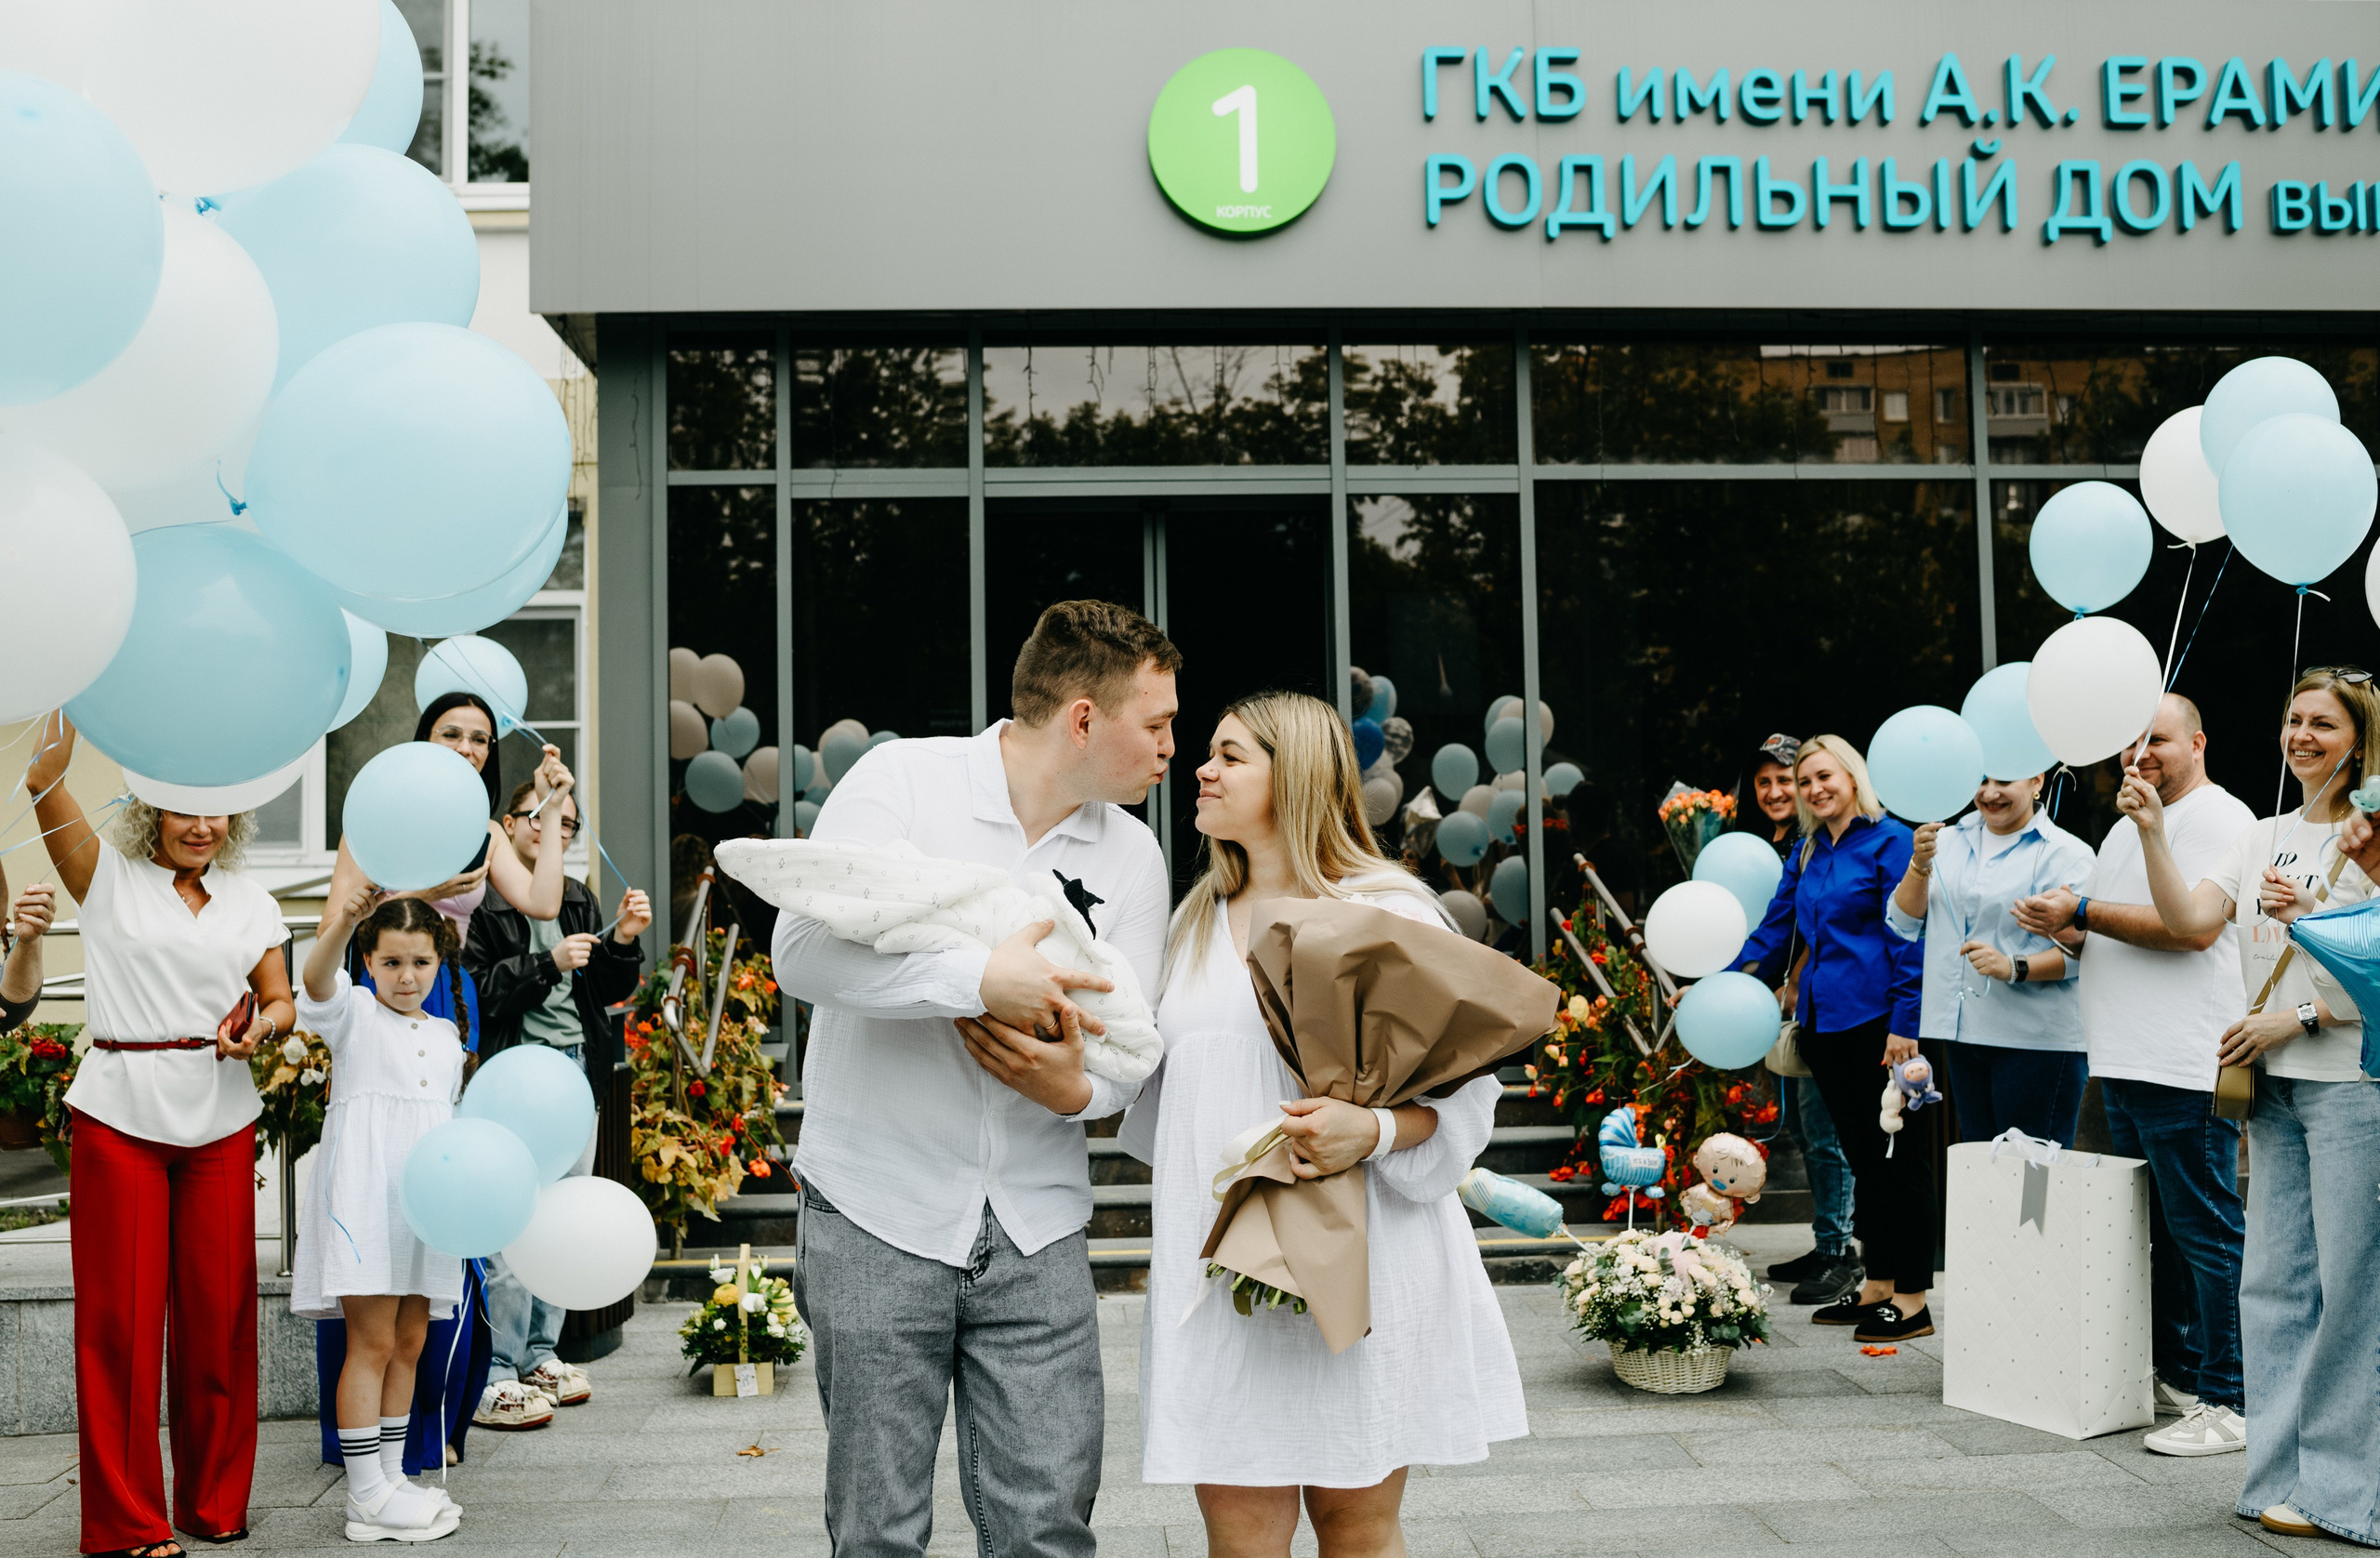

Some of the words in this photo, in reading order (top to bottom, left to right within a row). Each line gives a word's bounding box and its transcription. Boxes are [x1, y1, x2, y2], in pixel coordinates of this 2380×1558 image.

[1421, 46, 1586, 119] ГКБ
[1615, 65, 1896, 125] имени
[1918, 52, 2081, 126] А.К.
[1211, 84, 1258, 194] 1
[1215, 205, 1273, 219] КОРПУС
[1423, 138, 2019, 241] РОДИЛЬНЫЙ
[2043, 158, 2244, 245] ДОМ
[2272, 178, 2380, 232] вы
